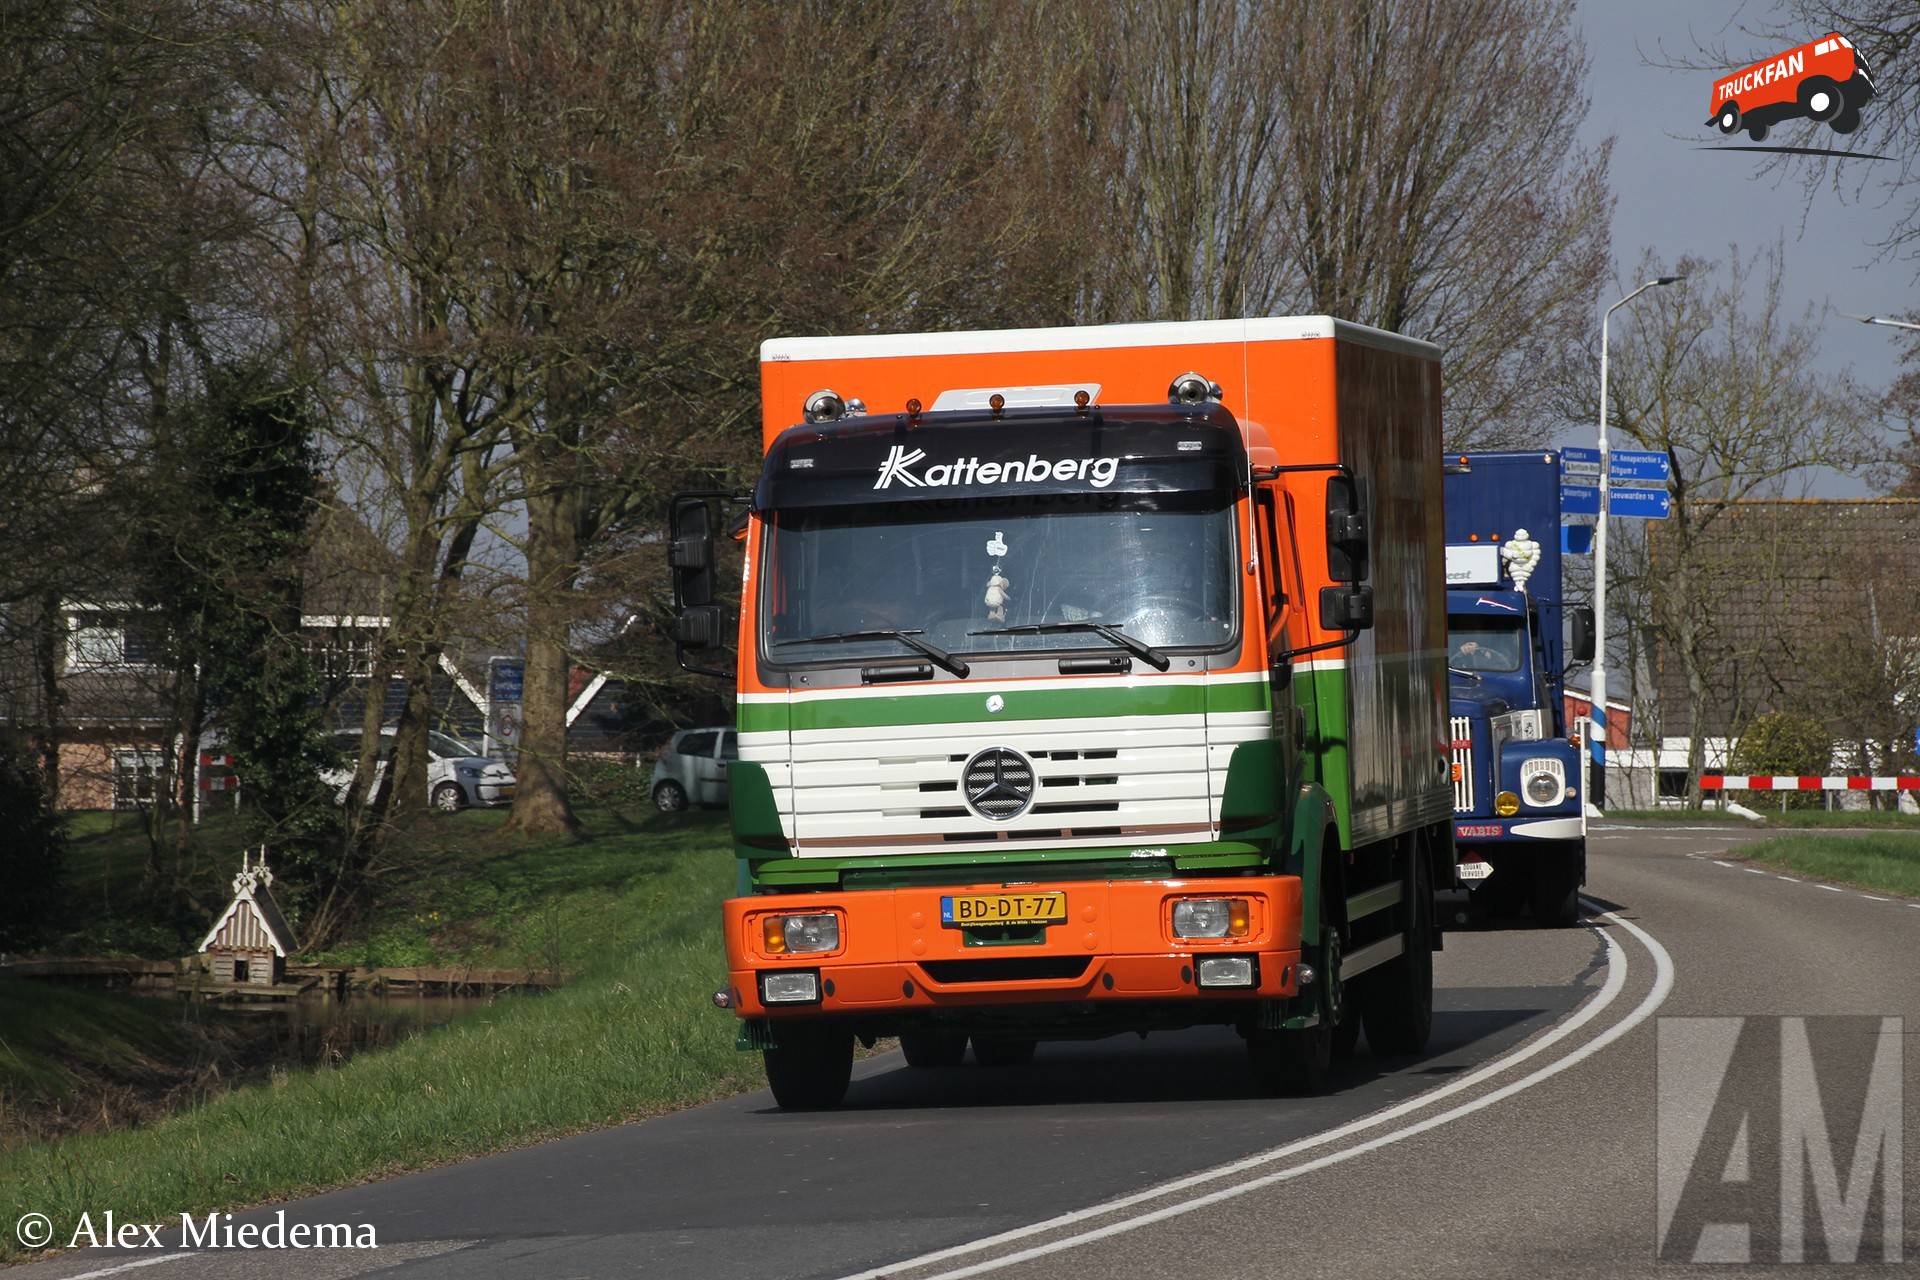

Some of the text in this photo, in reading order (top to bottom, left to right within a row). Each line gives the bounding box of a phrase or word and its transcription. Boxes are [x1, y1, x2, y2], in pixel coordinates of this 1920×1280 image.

[873, 445, 1119, 489] Kattenberg
[1610, 491, 1646, 500] Leeuwarden
[1459, 825, 1501, 836] VABIS
[960, 898, 1056, 918] BD-DT-77
